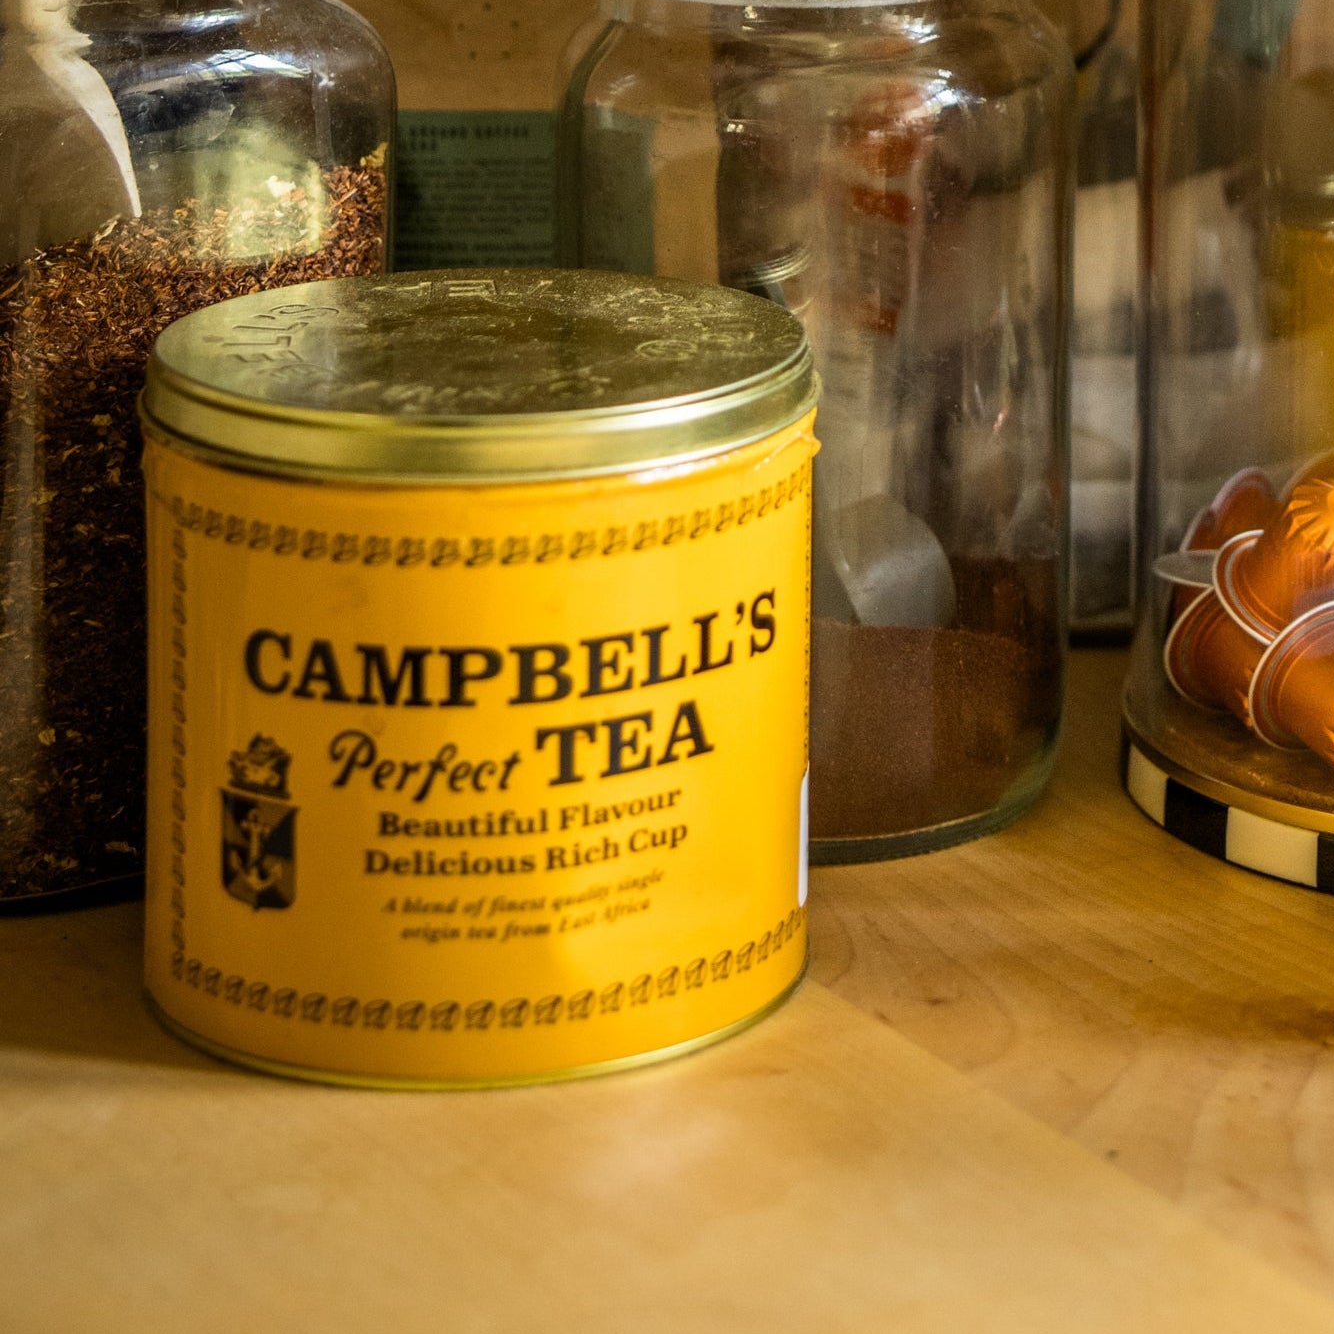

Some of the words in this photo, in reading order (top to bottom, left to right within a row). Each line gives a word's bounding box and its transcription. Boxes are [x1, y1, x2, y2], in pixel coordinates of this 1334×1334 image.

[243, 587, 776, 707] CAMPBELL'S
[328, 728, 521, 803] Perfect
[534, 699, 715, 788] TEA
[378, 808, 549, 838] Beautiful
[558, 787, 682, 831] Flavour
[364, 847, 537, 877] Delicious
[545, 835, 621, 872] Rich
[628, 823, 689, 854] Cup
[401, 921, 461, 944] origin
[466, 924, 498, 940] tea
[500, 919, 551, 944] from
[402, 895, 459, 915] blend
[462, 896, 487, 918] of
[487, 894, 546, 920] finest
